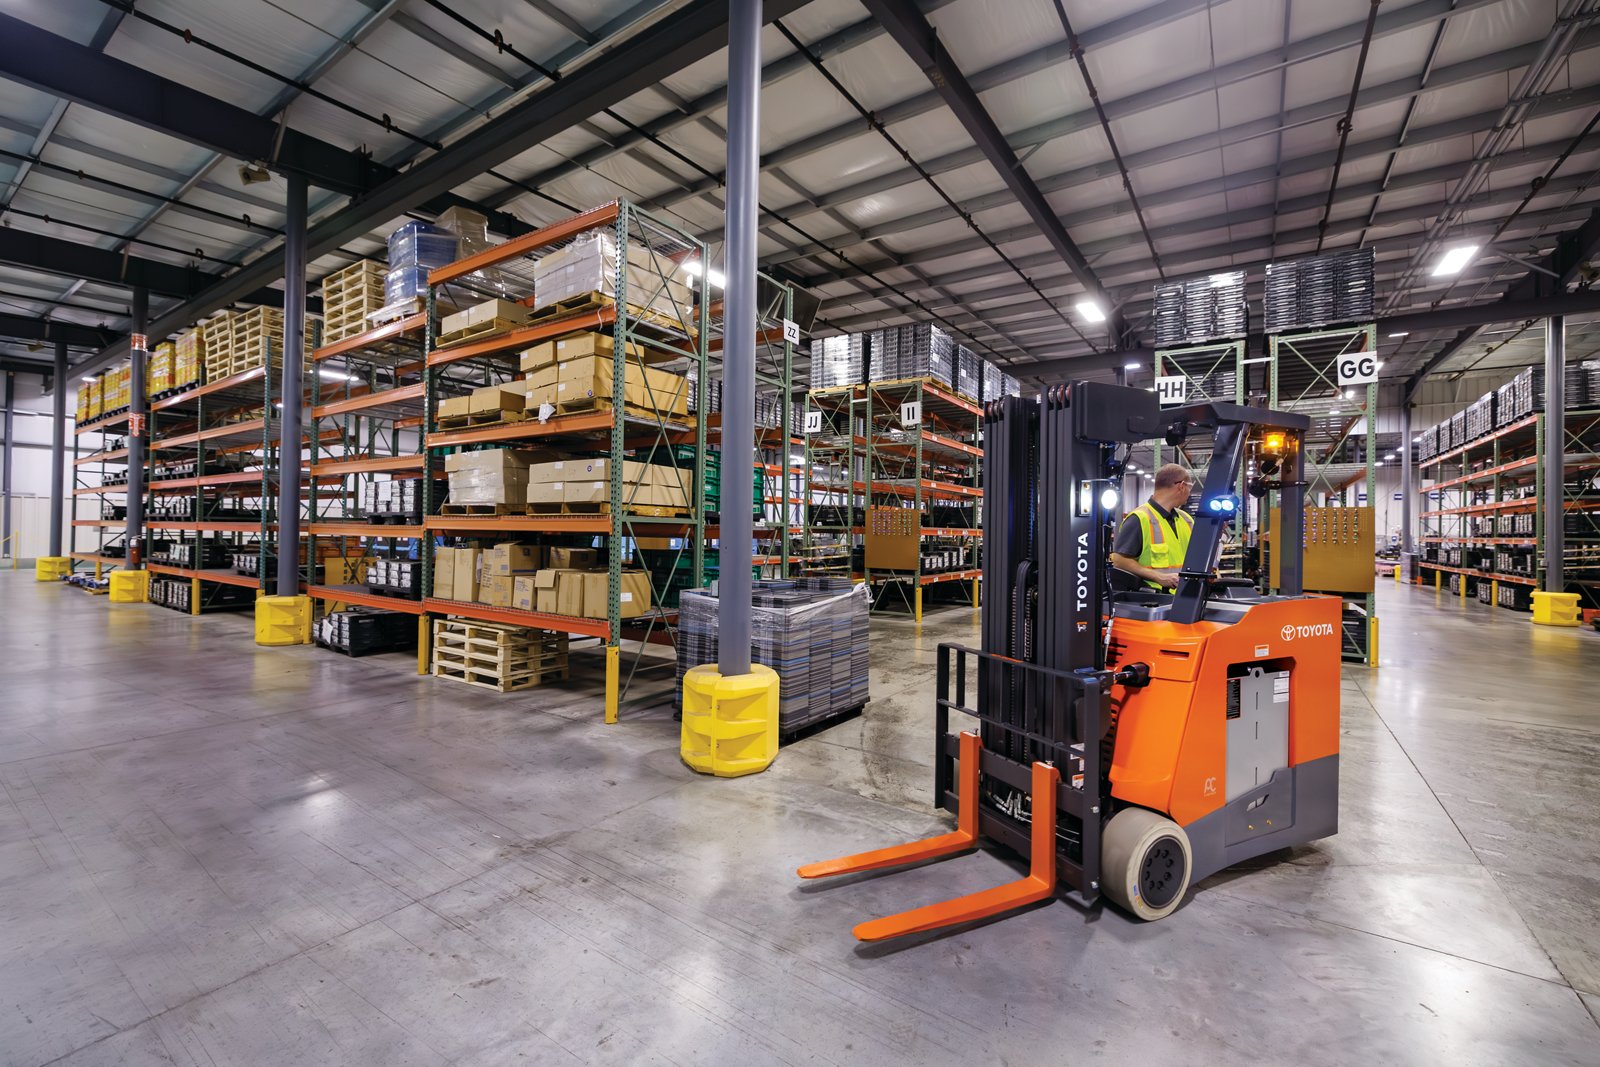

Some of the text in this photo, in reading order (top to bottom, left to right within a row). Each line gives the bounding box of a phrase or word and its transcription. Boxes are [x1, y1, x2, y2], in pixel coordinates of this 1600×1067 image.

[787, 326, 797, 339] ZZ
[1340, 358, 1375, 379] GG
[1157, 381, 1184, 398] HH
[808, 416, 818, 429] JJ
[1076, 532, 1089, 612] TOYOTA
[1296, 623, 1334, 639] TOYOTA
